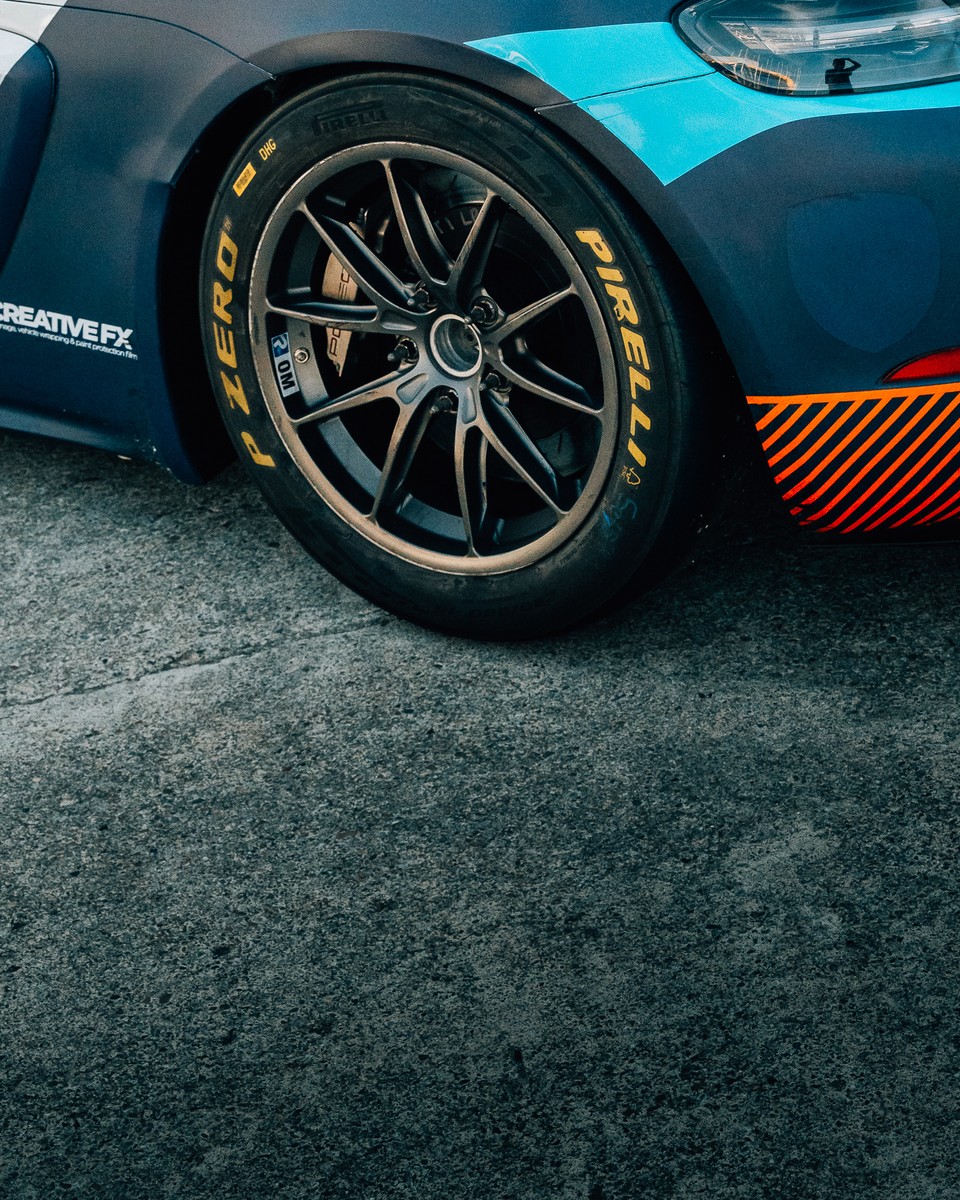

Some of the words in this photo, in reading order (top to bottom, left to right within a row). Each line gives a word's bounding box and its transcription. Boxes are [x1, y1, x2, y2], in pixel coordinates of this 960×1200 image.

[259, 138, 277, 161] DHG
[17, 327, 39, 337] vehicle
[38, 332, 70, 344] wrapping
[70, 337, 76, 346] &
[75, 339, 93, 351] paint
[92, 344, 126, 357] protection
[125, 351, 139, 361] film
[212, 230, 251, 415] ZERO
[574, 227, 652, 468] PIRELLI
